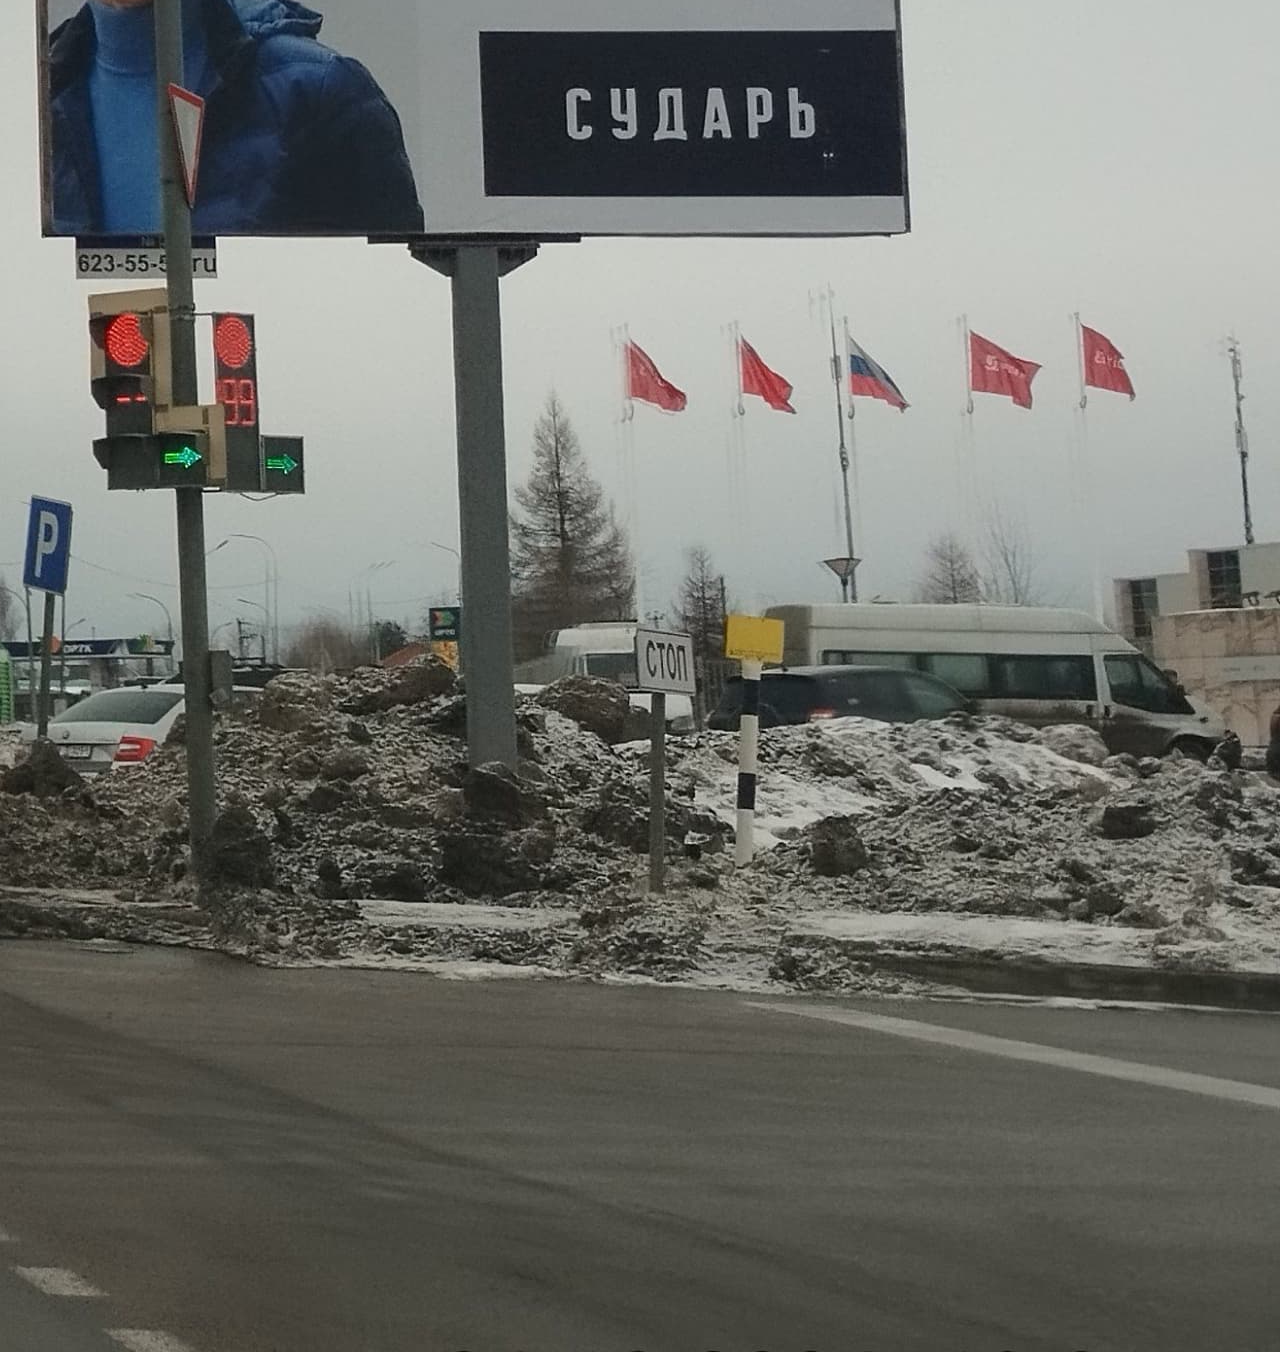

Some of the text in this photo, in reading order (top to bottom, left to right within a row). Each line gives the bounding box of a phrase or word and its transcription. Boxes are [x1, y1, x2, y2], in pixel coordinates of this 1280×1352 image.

[565, 87, 816, 141] СУДАРЬ
[34, 510, 60, 579] P
[646, 639, 688, 682] СТОП
